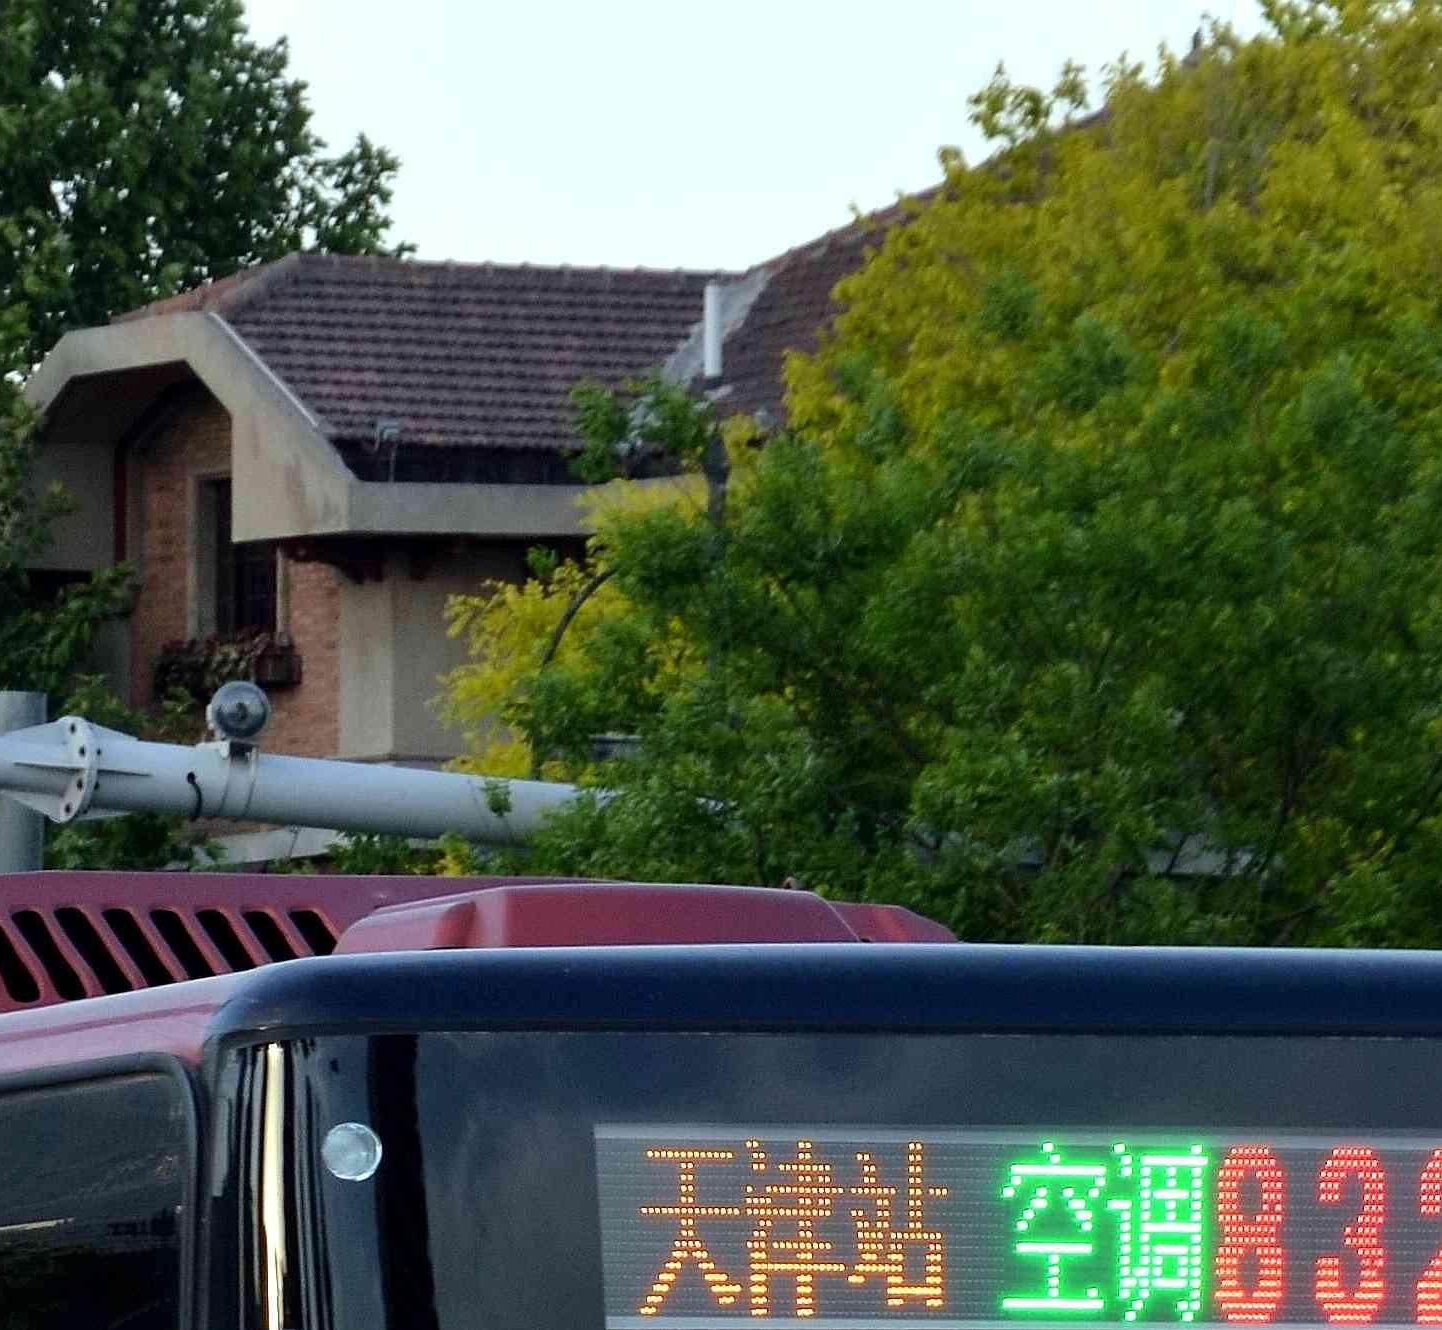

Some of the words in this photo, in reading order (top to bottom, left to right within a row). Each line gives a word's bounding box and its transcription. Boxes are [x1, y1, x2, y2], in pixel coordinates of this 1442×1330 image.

[636, 1139, 950, 1318] 天津站
[1000, 1140, 1210, 1323] 空调
